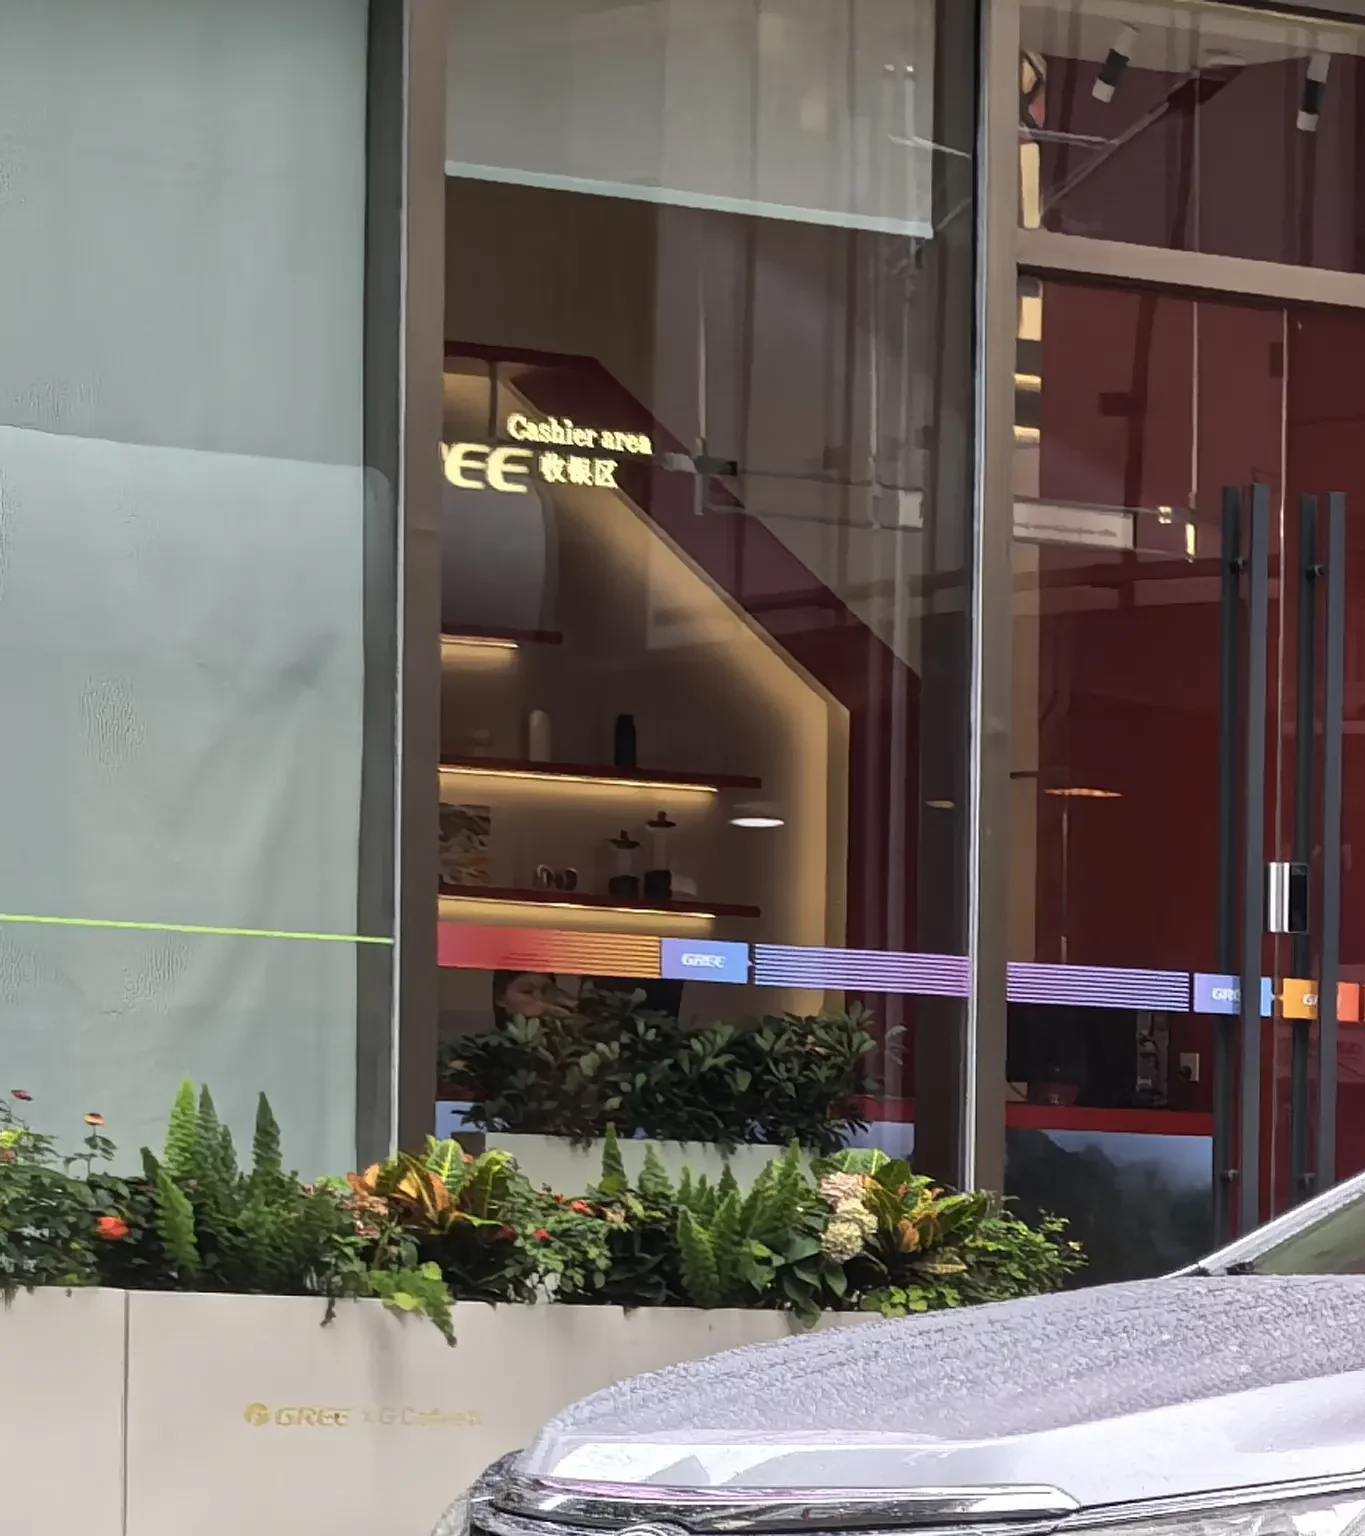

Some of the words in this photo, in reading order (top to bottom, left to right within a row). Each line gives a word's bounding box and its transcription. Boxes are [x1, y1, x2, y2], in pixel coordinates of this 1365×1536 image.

[506, 412, 599, 449] Cashier
[601, 429, 653, 456] area
[439, 443, 534, 493] EE
